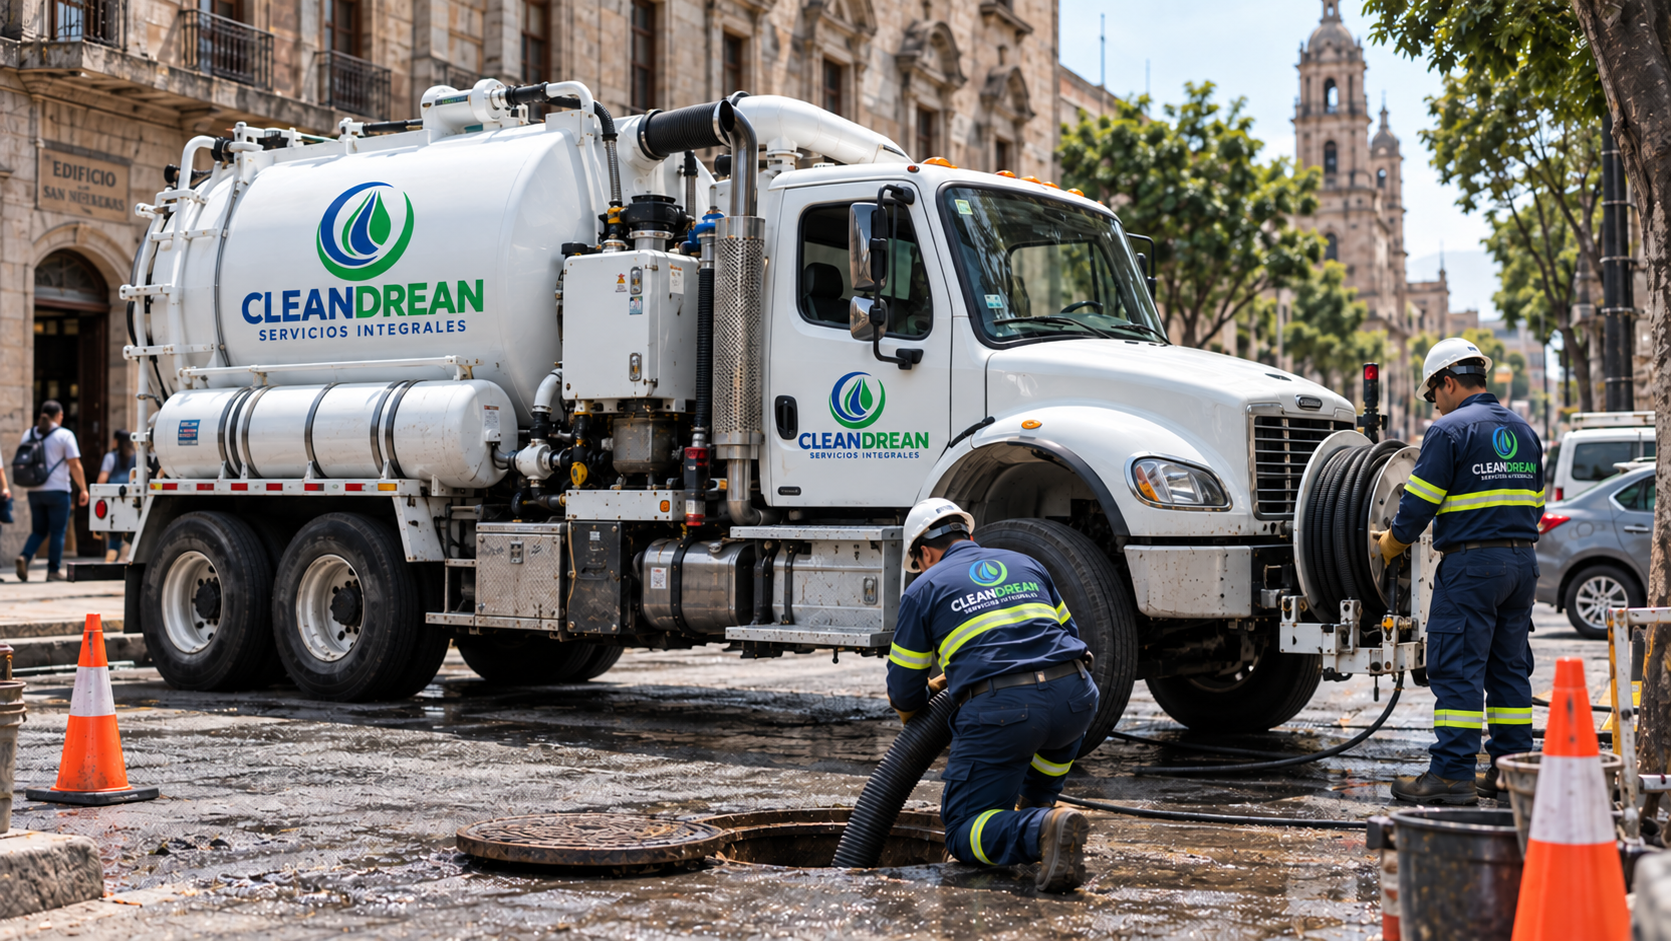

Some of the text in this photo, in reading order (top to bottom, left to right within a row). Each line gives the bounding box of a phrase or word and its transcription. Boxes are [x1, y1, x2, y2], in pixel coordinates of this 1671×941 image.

[53, 160, 116, 188] EDIFICIO
[43, 185, 66, 201] SAN
[241, 279, 484, 325] CLEANDREAN
[259, 319, 466, 341] SERVICIOS INTEGRALES
[798, 431, 929, 450] CLEANDREAN
[809, 451, 920, 459] SERVICIOS INTEGRALES
[1471, 461, 1537, 475] CLEANDREAN
[950, 581, 1040, 612] CLEANDREAN
